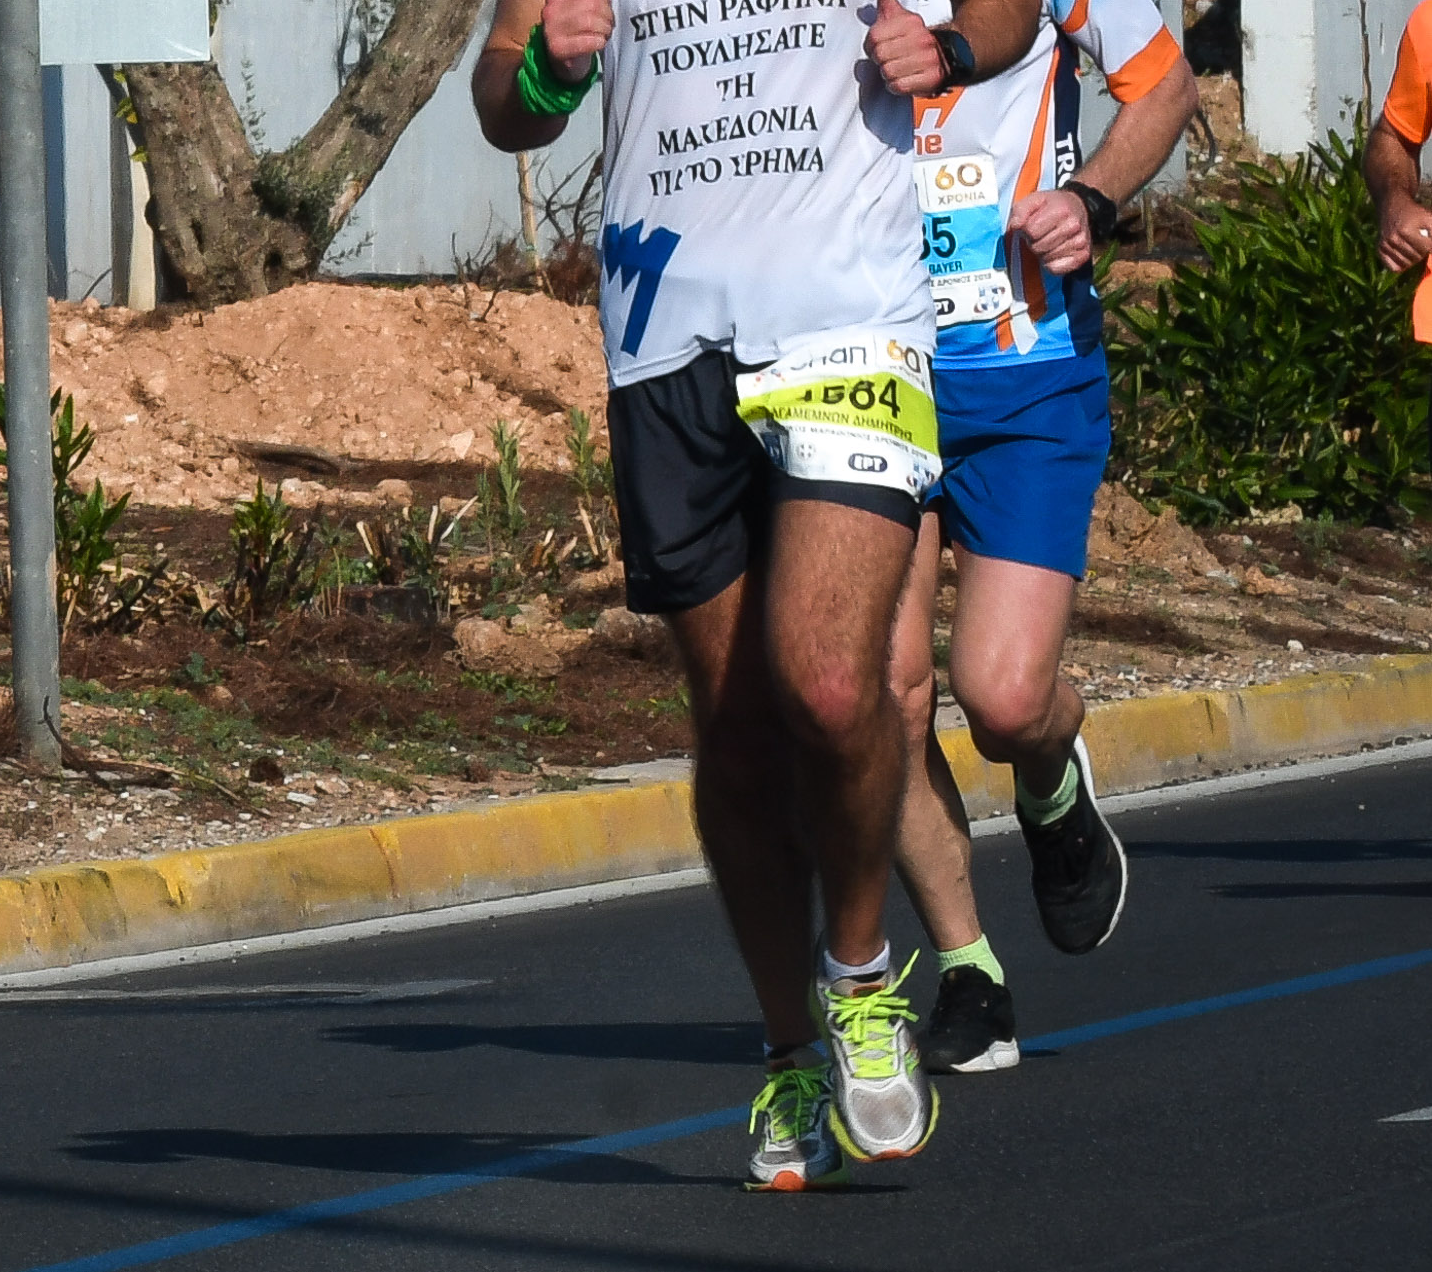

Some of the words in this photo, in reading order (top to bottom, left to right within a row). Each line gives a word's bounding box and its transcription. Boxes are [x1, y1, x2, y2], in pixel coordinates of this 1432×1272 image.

[629, 0, 708, 42] ΣΤΗΝ
[650, 22, 827, 77] ΠΟΥΛΗΣΑΤΕ
[715, 71, 756, 102] ΤΗ
[656, 104, 819, 157] ΜΑΚΕΔΟΝΙΑ
[684, 157, 722, 184] ΤΟ
[731, 146, 826, 178] ΧΡΗΜΑ
[934, 162, 983, 191] 60
[937, 191, 986, 206] ΧΡΟΝΙΑ
